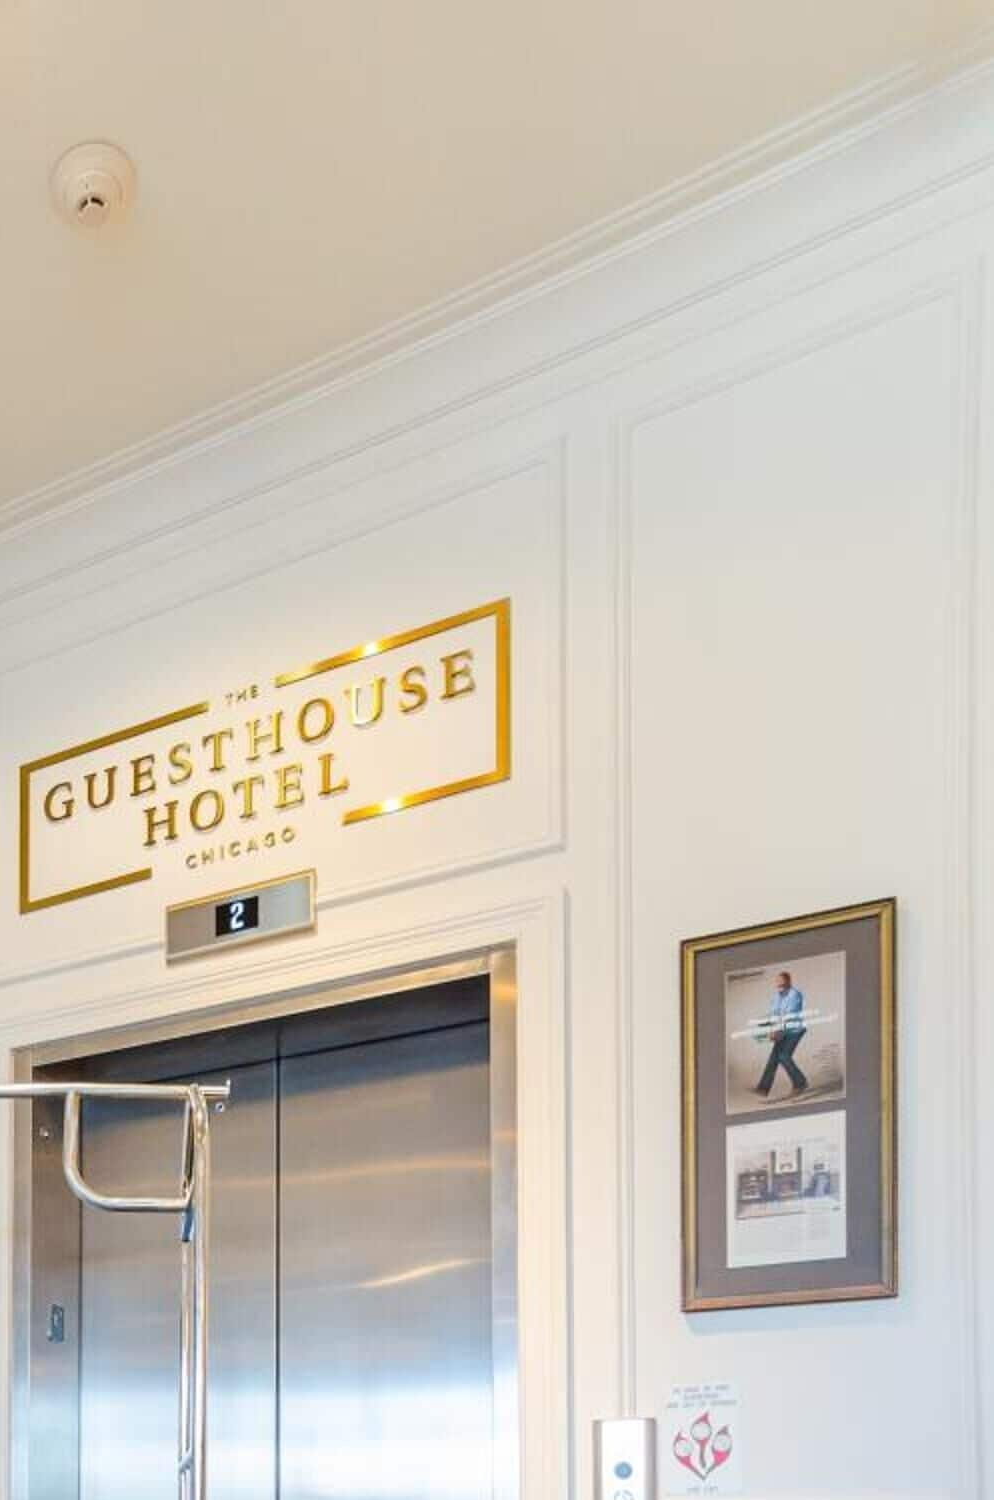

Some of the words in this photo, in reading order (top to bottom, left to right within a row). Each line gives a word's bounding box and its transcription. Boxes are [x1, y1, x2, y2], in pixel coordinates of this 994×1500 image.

[225, 685, 260, 705] THE
[44, 648, 476, 822] GUESTHOUSE
[143, 752, 350, 846] HOTEL
[185, 826, 296, 869] CHICAGO
[229, 901, 245, 930] 2
